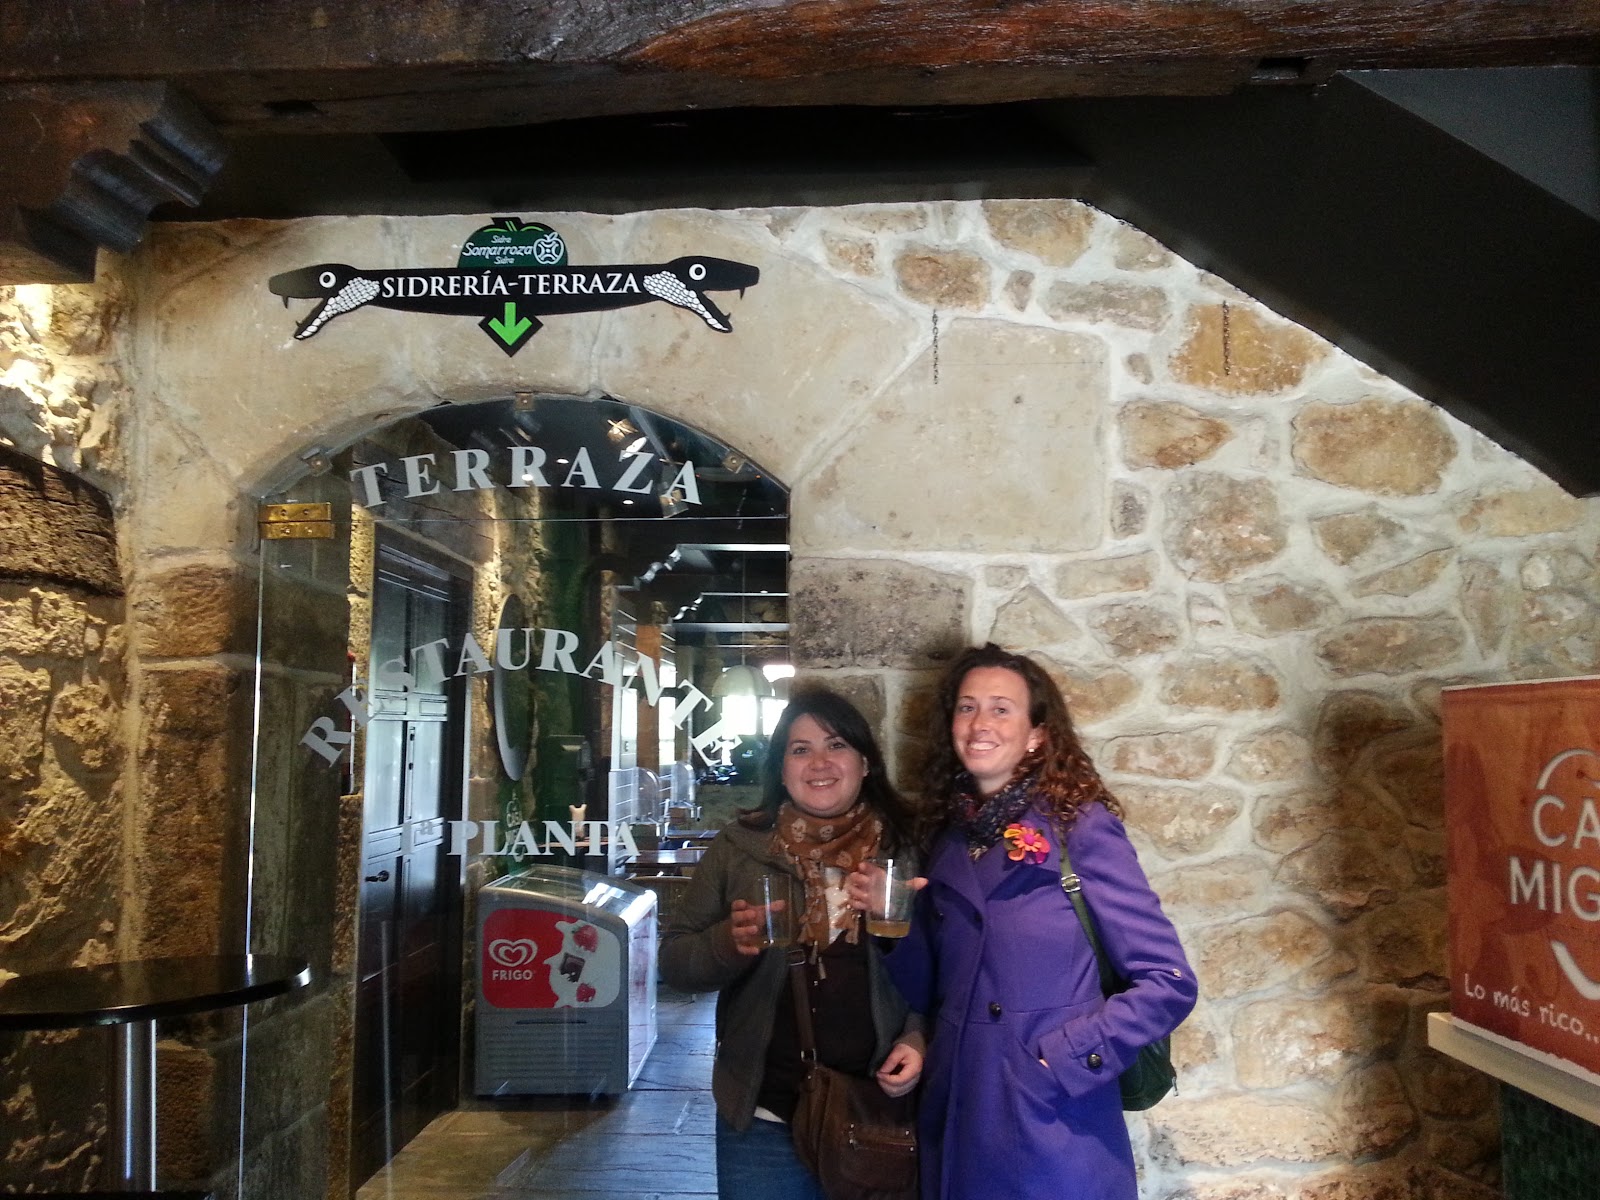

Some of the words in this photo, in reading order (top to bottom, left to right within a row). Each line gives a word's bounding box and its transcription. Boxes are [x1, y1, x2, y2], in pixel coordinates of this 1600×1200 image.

[462, 242, 534, 259] Somarroza
[381, 270, 641, 298] SIDRERÍA-TERRAZA
[350, 446, 702, 508] TERRAZA
[298, 627, 743, 768] RESTAURANTE
[446, 820, 642, 856] PLANTA
[492, 969, 533, 981] FRIGO
[1464, 972, 1486, 1000] Lo
[1493, 985, 1530, 1017] más
